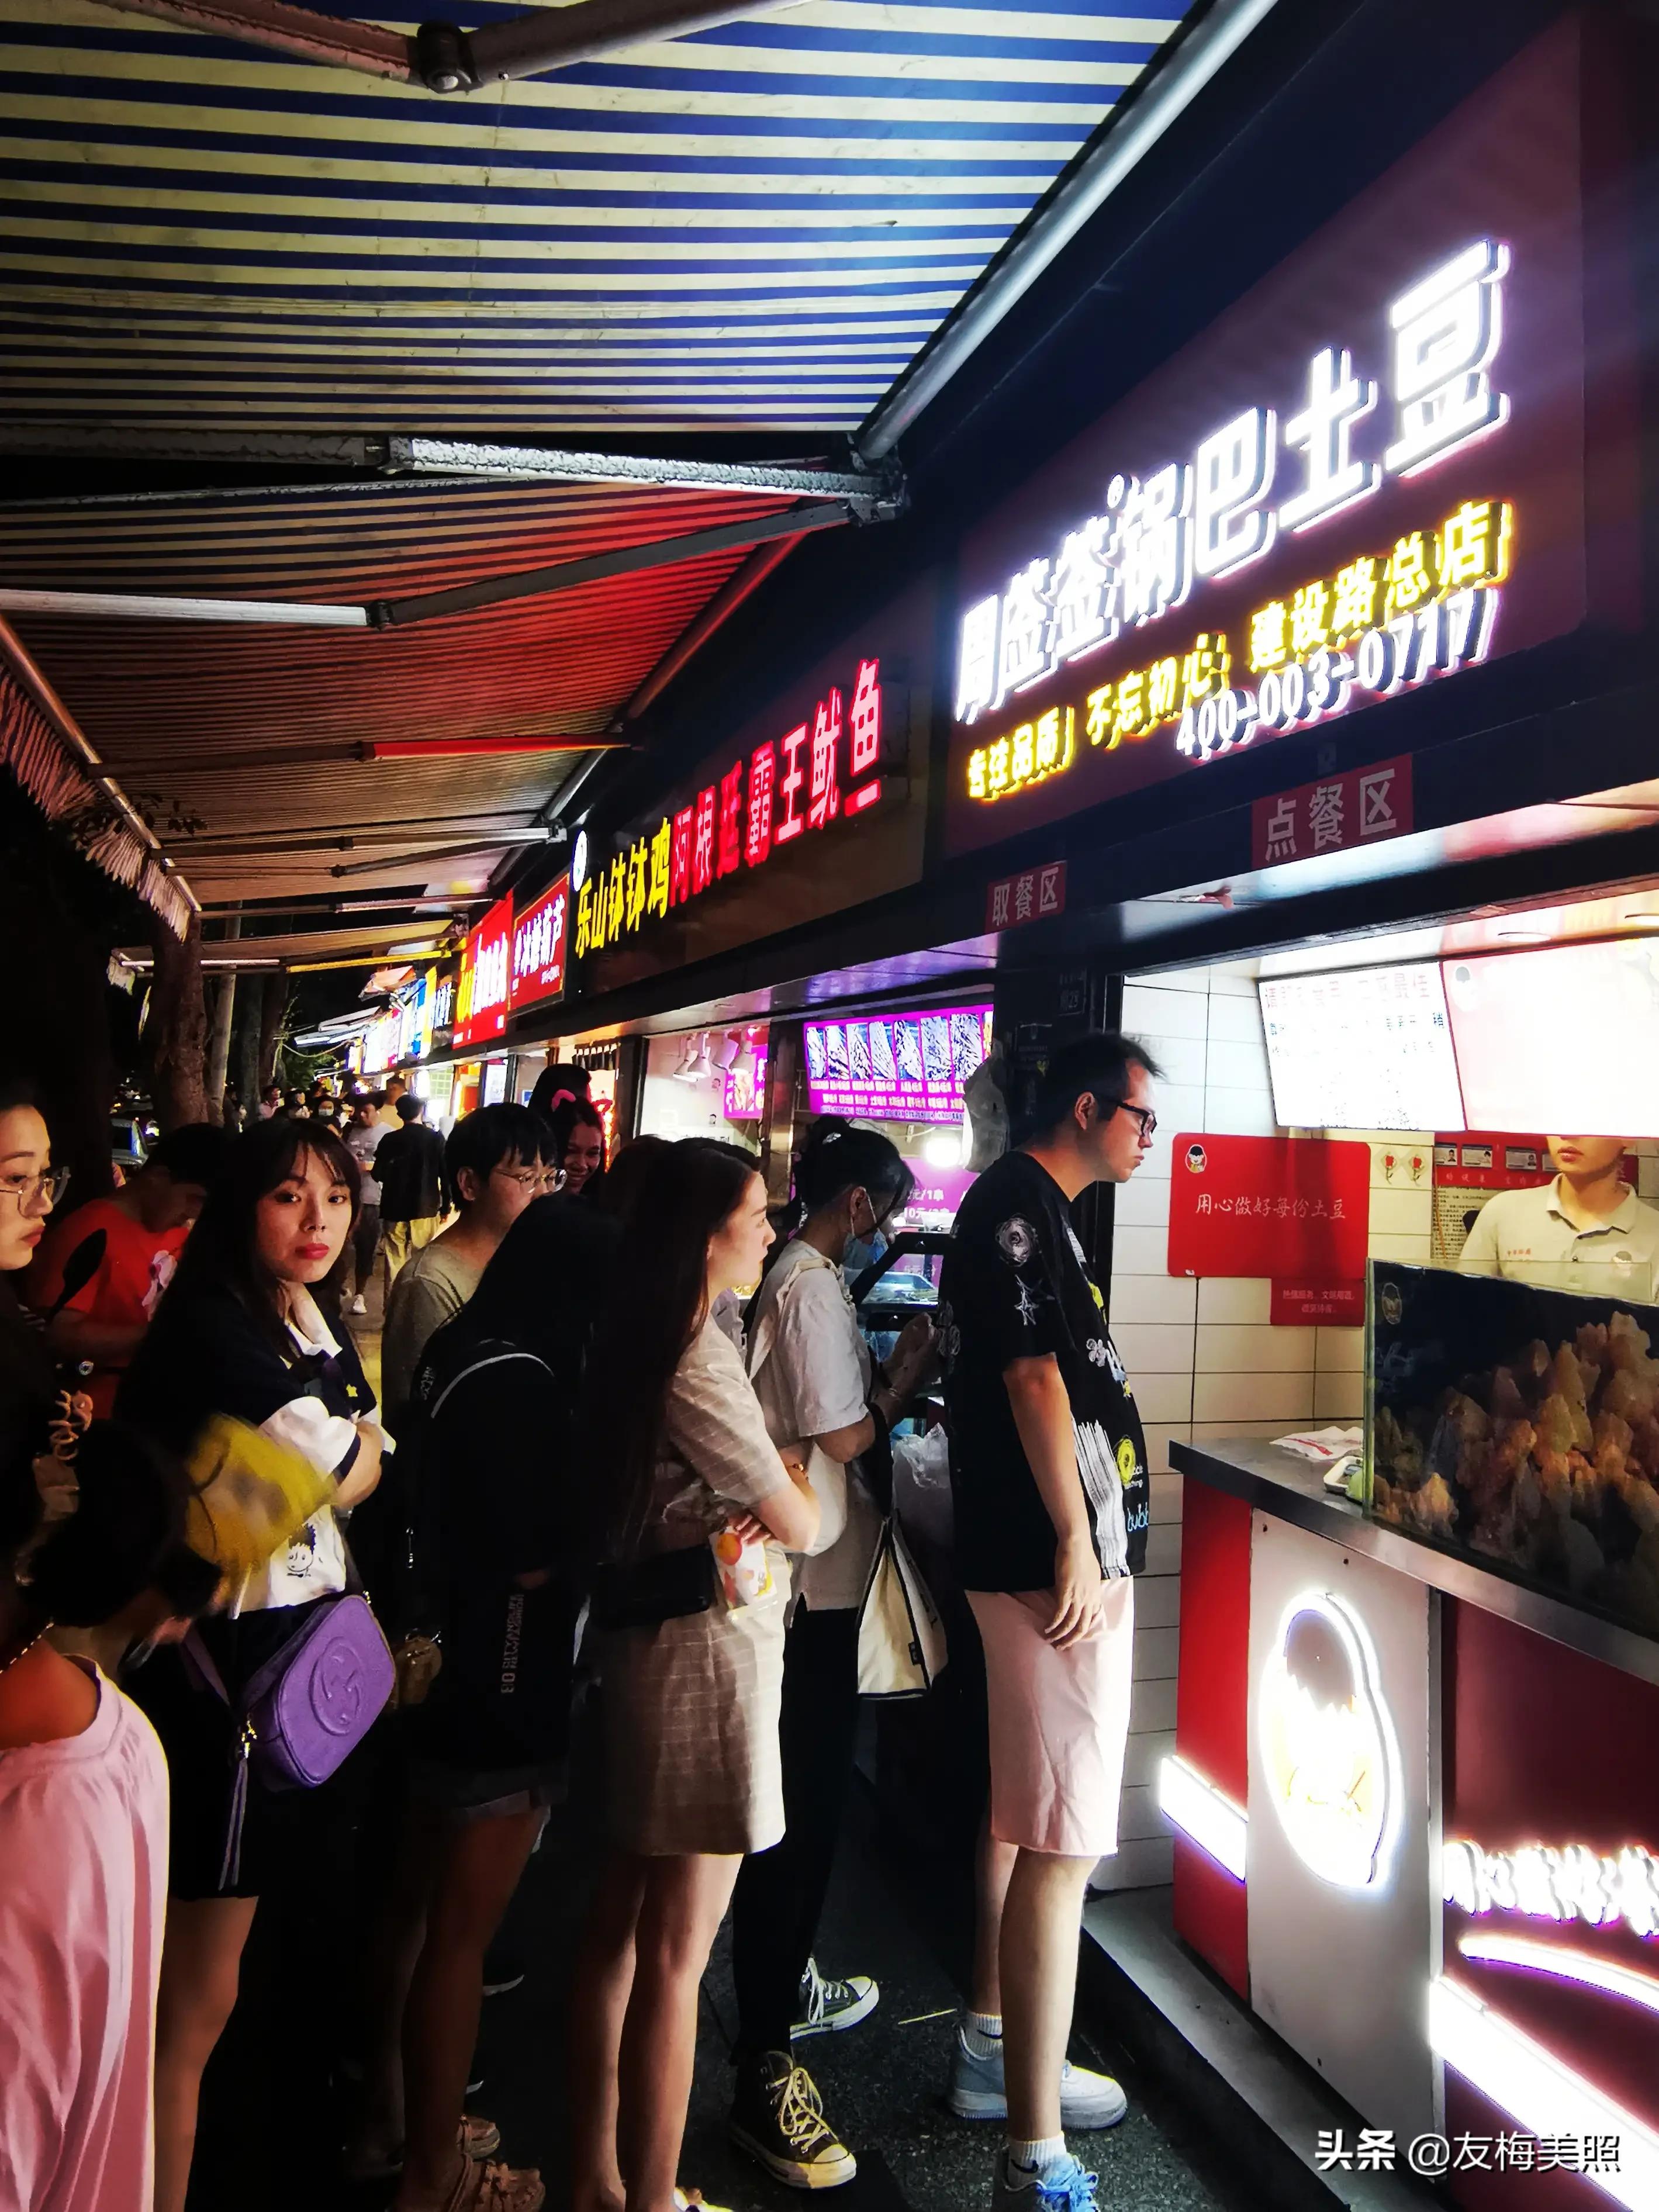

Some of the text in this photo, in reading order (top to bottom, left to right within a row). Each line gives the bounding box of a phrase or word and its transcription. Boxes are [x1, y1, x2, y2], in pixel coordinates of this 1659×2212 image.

[1086, 631, 1230, 749] 不忘初心
[1250, 500, 1511, 673] 建设路总店
[1176, 587, 1500, 762] 400-003-0717
[1265, 769, 1398, 862] 点餐区
[575, 817, 671, 958] 乐山钵钵鸡
[992, 866, 1059, 926] 取餐区
[1195, 1193, 1346, 1219] 用心做好每份土豆
